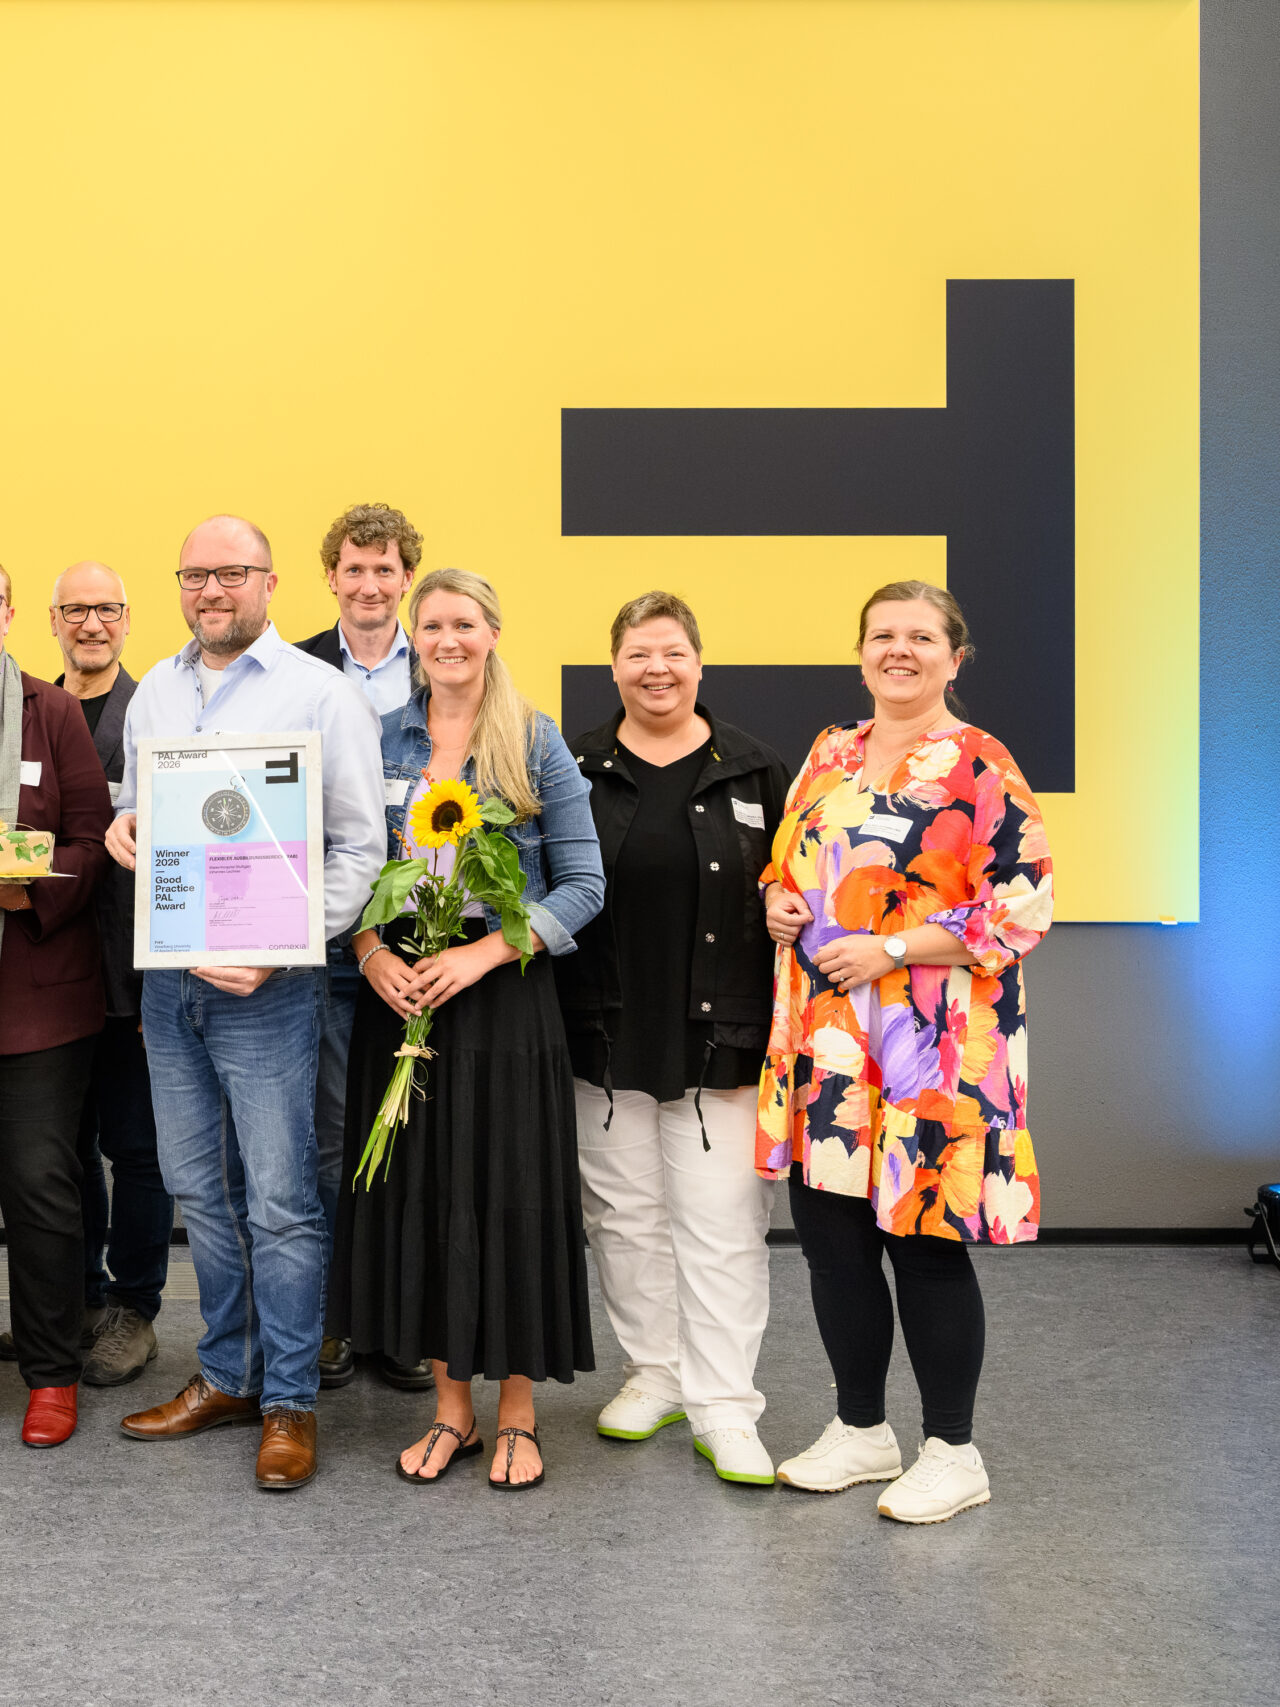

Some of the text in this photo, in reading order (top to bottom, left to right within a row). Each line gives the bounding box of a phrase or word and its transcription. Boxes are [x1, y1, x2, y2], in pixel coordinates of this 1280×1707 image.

[158, 750, 207, 760] PAL Award
[158, 761, 181, 769] 2026
[155, 849, 189, 858] Winner
[155, 858, 180, 867] 2026
[155, 876, 182, 884] Good
[155, 885, 195, 893] Practice
[155, 894, 173, 902] PAL
[155, 902, 186, 911] Award
